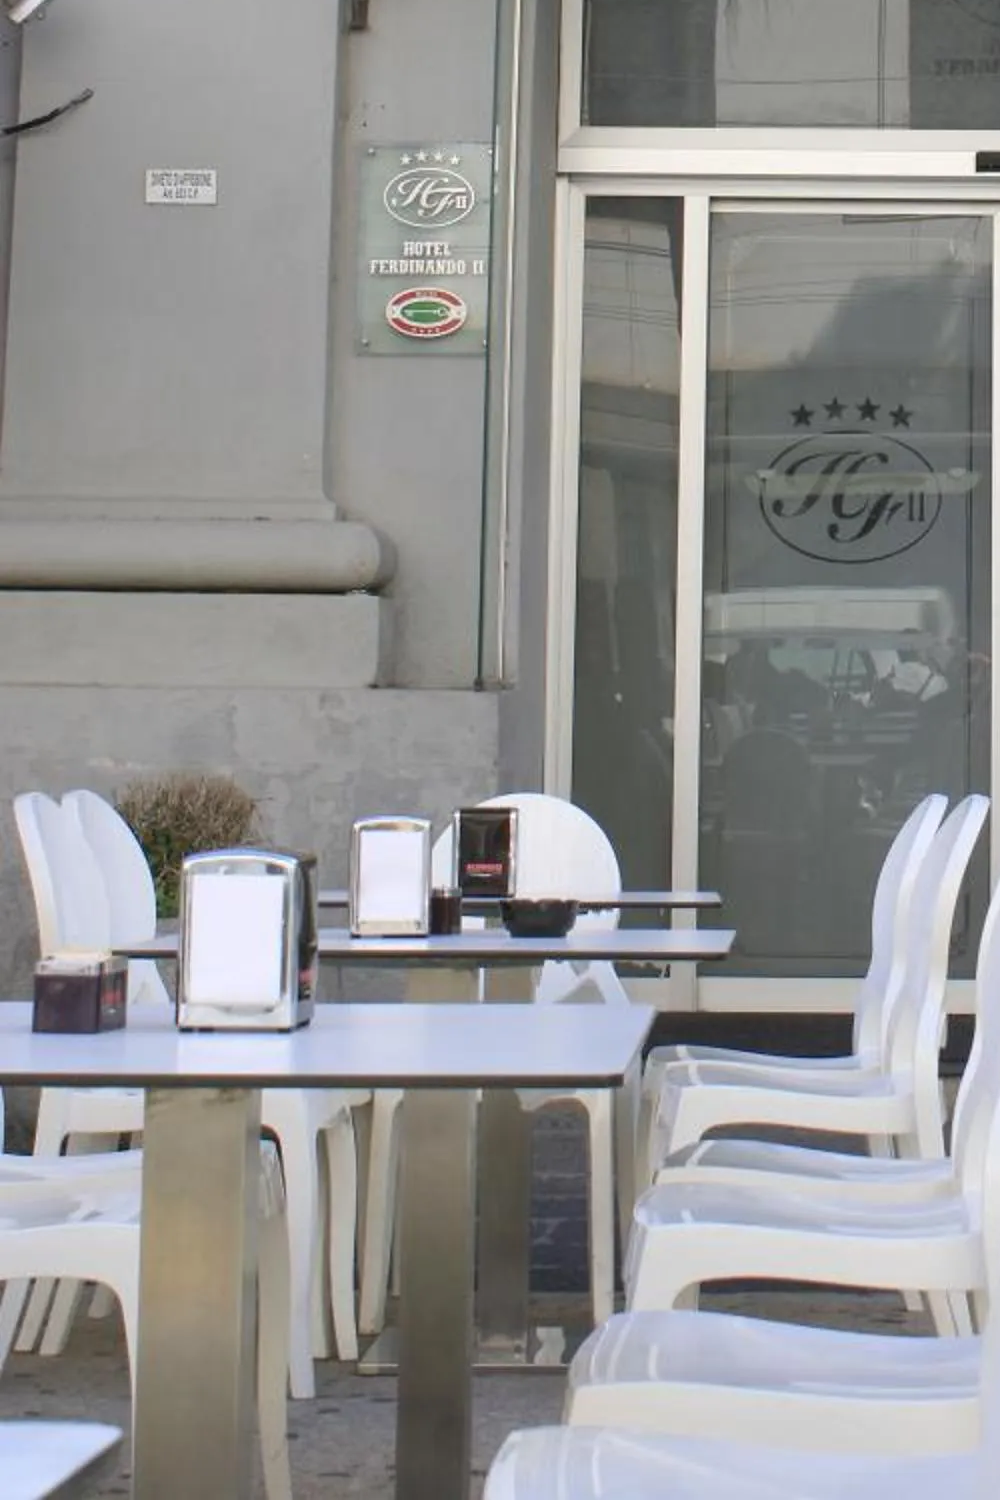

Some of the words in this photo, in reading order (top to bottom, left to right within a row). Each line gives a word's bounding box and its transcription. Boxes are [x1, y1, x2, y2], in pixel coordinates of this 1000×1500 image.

[402, 241, 452, 257] HOTEL
[369, 259, 466, 275] FERDINANDO
[472, 259, 484, 275] II
